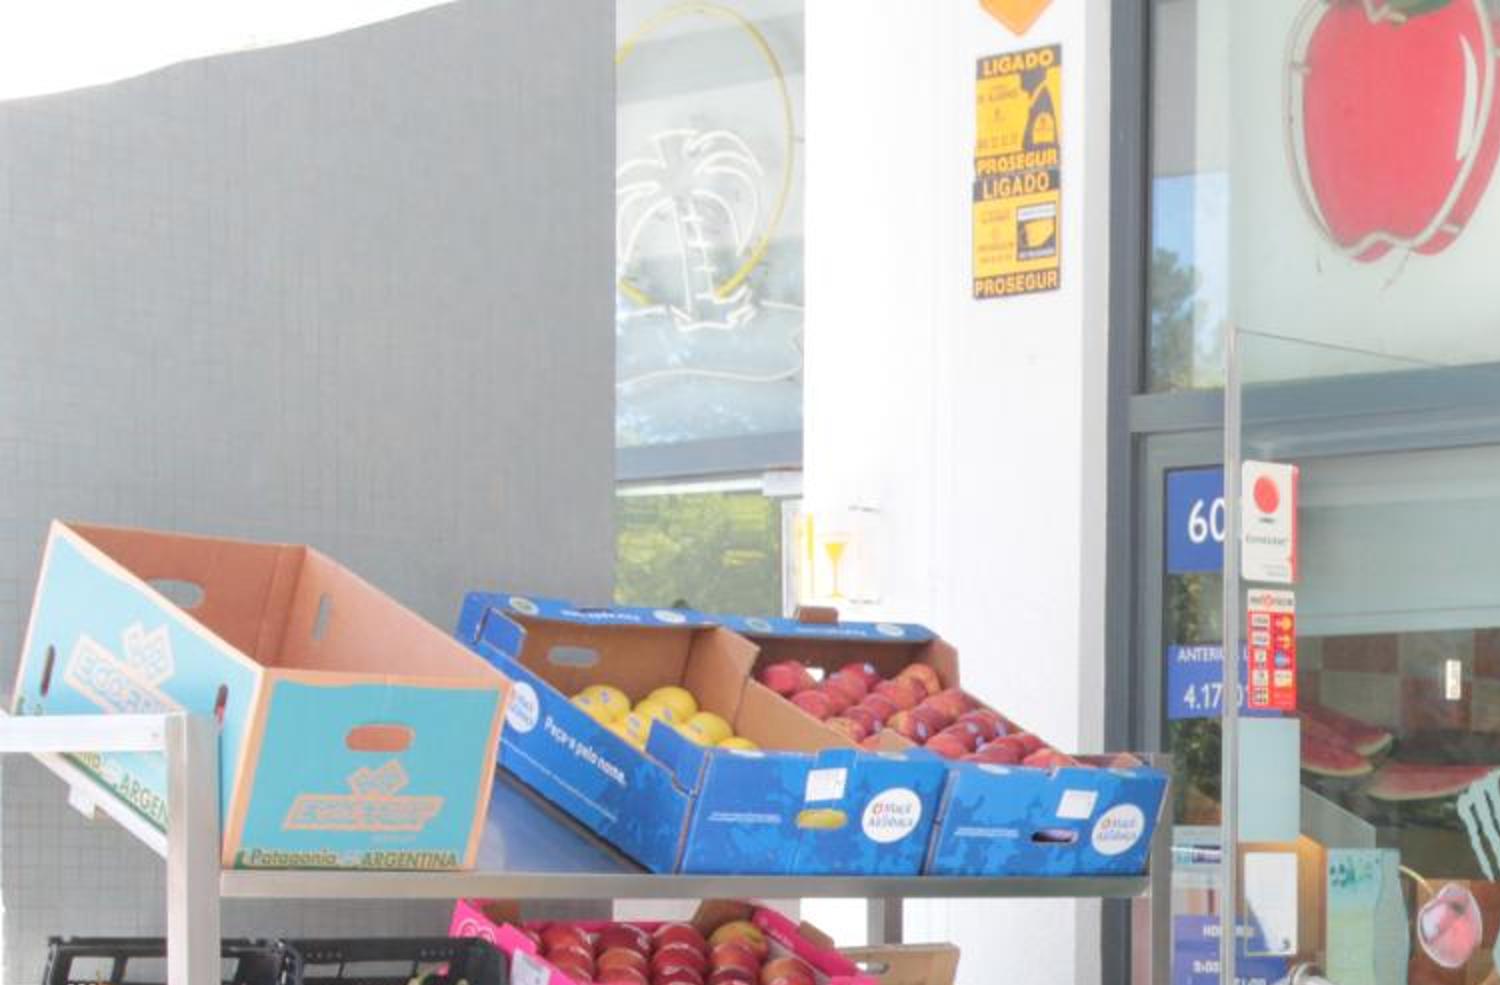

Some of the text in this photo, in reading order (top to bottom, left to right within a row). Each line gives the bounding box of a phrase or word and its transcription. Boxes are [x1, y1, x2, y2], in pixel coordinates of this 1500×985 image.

[983, 50, 1054, 76] LIGADO
[976, 150, 1057, 174] PROSEGUR
[982, 171, 1050, 198] LIGADO
[975, 270, 1057, 296] PROSEGUR
[362, 850, 458, 868] ARGENTINA
